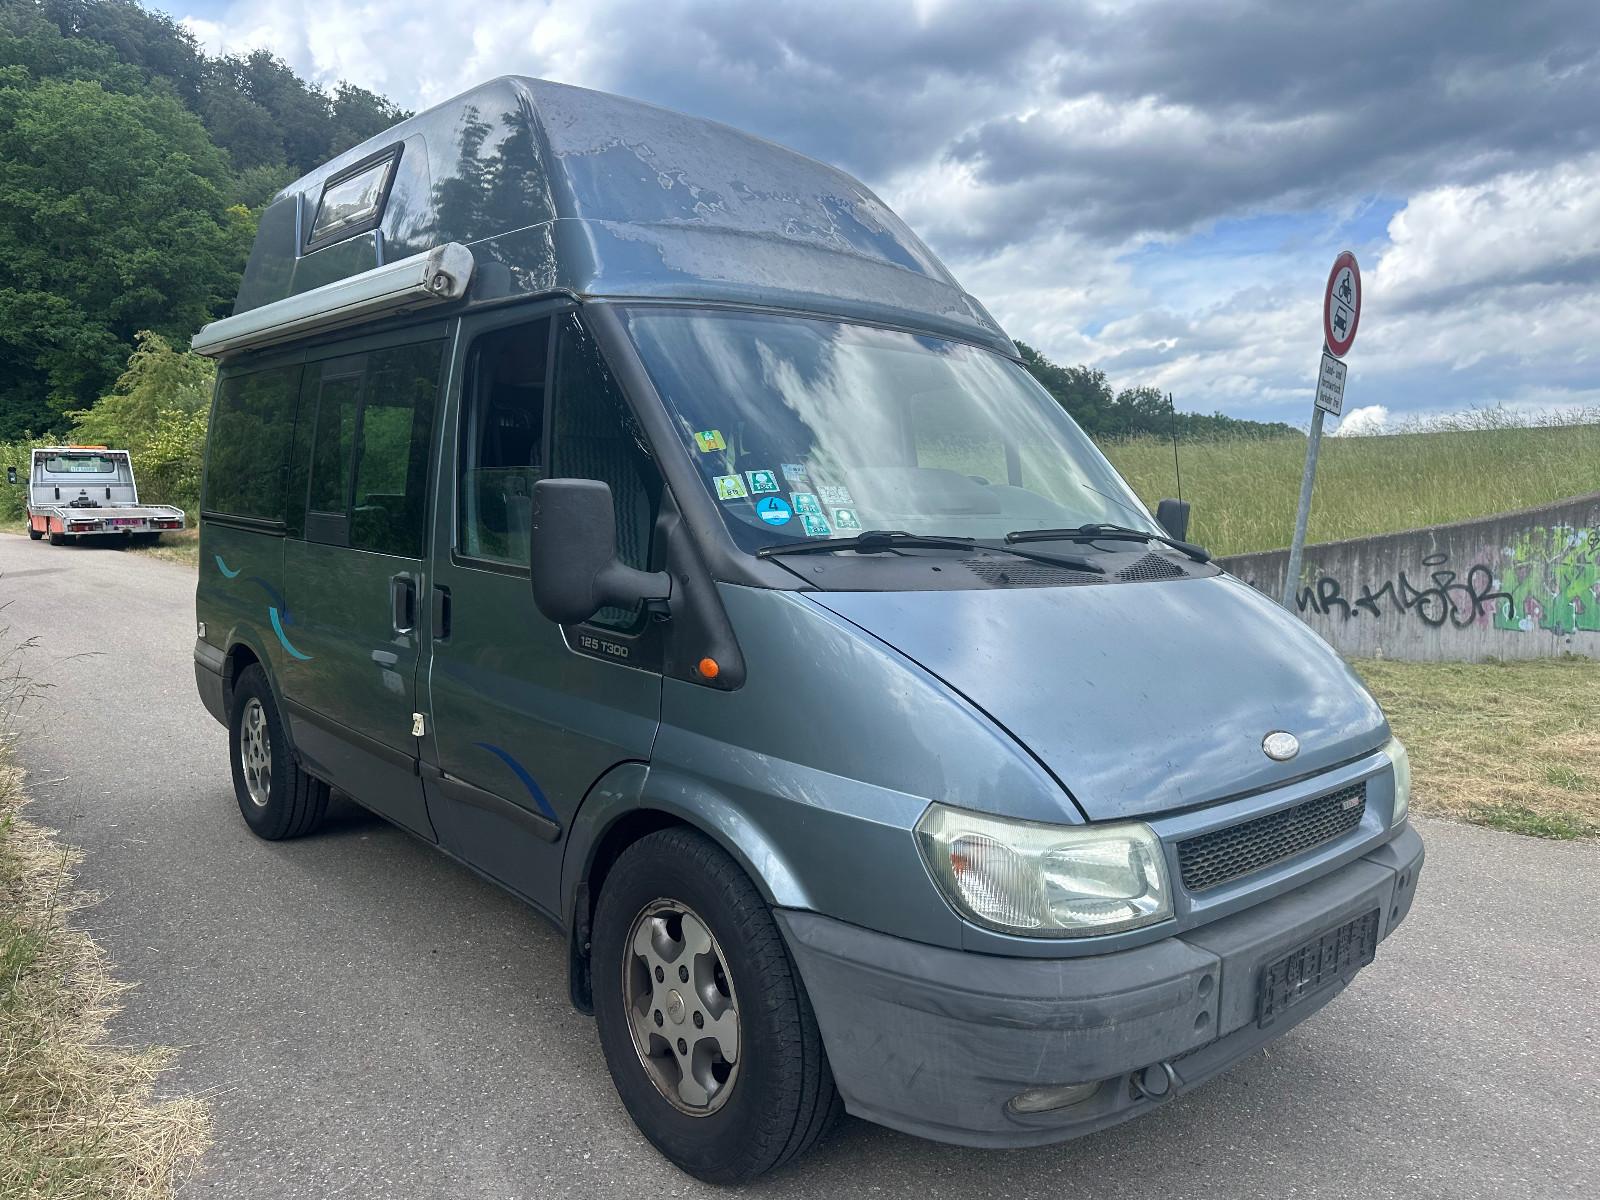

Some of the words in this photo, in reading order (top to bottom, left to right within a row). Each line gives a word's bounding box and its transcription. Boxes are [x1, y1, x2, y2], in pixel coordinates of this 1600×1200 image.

[768, 497, 779, 511] 4
[580, 635, 599, 650] 125
[601, 641, 629, 658] T300
